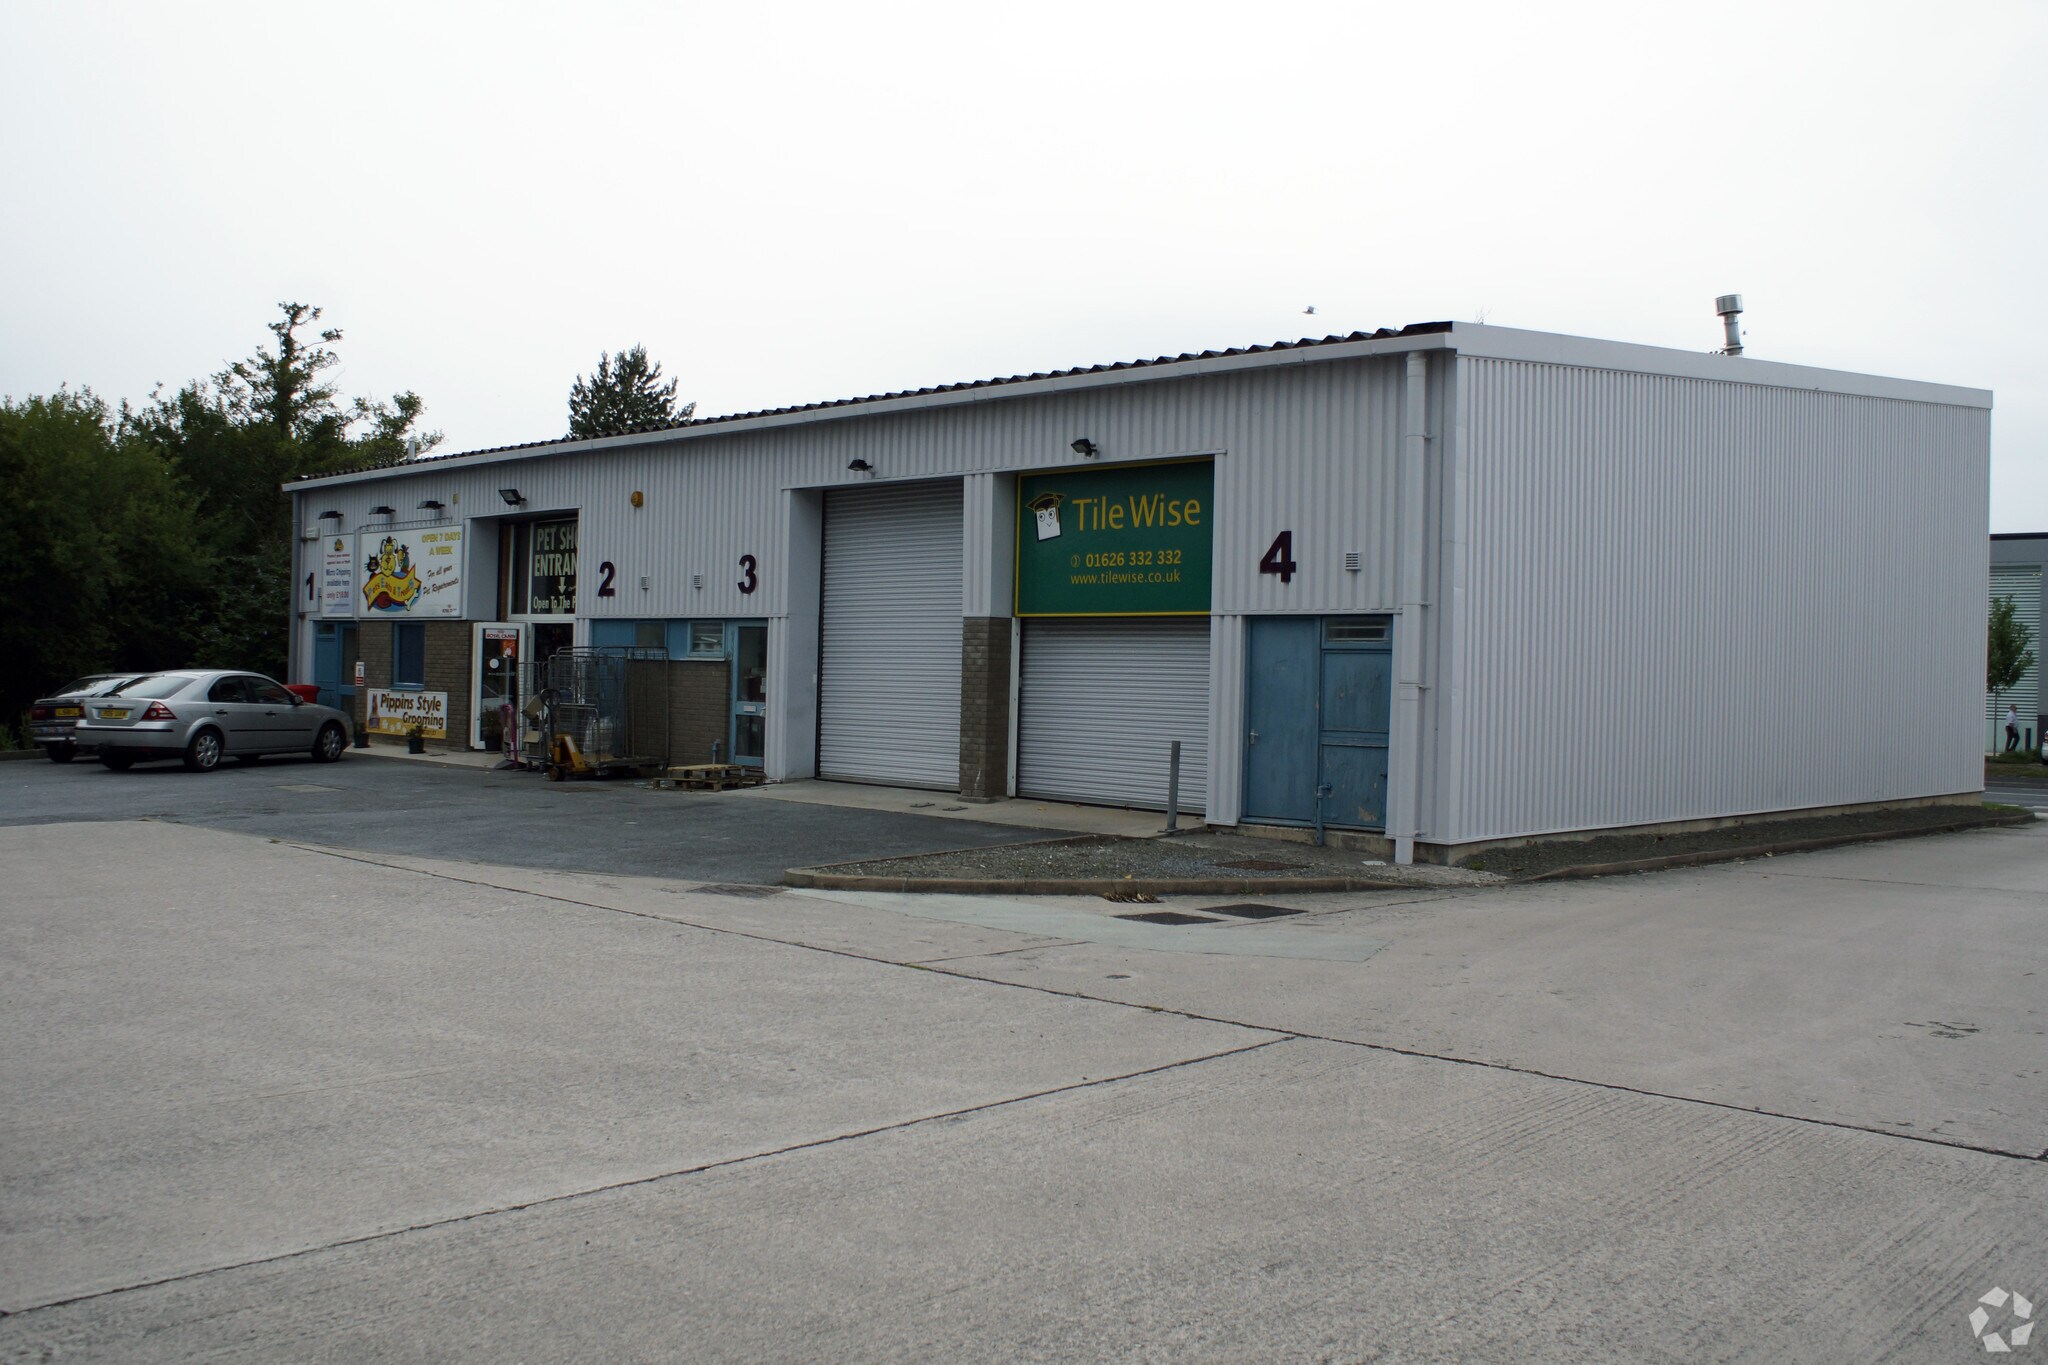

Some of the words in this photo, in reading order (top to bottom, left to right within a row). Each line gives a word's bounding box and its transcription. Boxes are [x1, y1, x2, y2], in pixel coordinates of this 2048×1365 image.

[1072, 496, 1124, 531] Tile
[1129, 493, 1201, 528] Wise
[422, 533, 438, 543] OPEN
[439, 533, 444, 542] 7
[445, 531, 462, 541] DAYS
[536, 526, 557, 551] PET
[428, 546, 435, 556] A
[436, 545, 453, 555] WEEK
[1085, 552, 1125, 568] 01626
[1129, 551, 1152, 566] 332
[1157, 549, 1182, 565] 332
[1260, 530, 1297, 584] 4
[443, 565, 453, 576] your
[598, 561, 616, 597] 2
[737, 554, 757, 595] 3
[1070, 569, 1181, 585] www.tilewise.co.uk
[305, 572, 315, 600] 1
[423, 586, 431, 596] Pet
[533, 595, 549, 612] Open
[550, 595, 558, 609] To
[559, 594, 571, 609] The
[380, 693, 414, 713] Pippins
[417, 695, 441, 714] Style
[403, 712, 444, 729] Grooming
